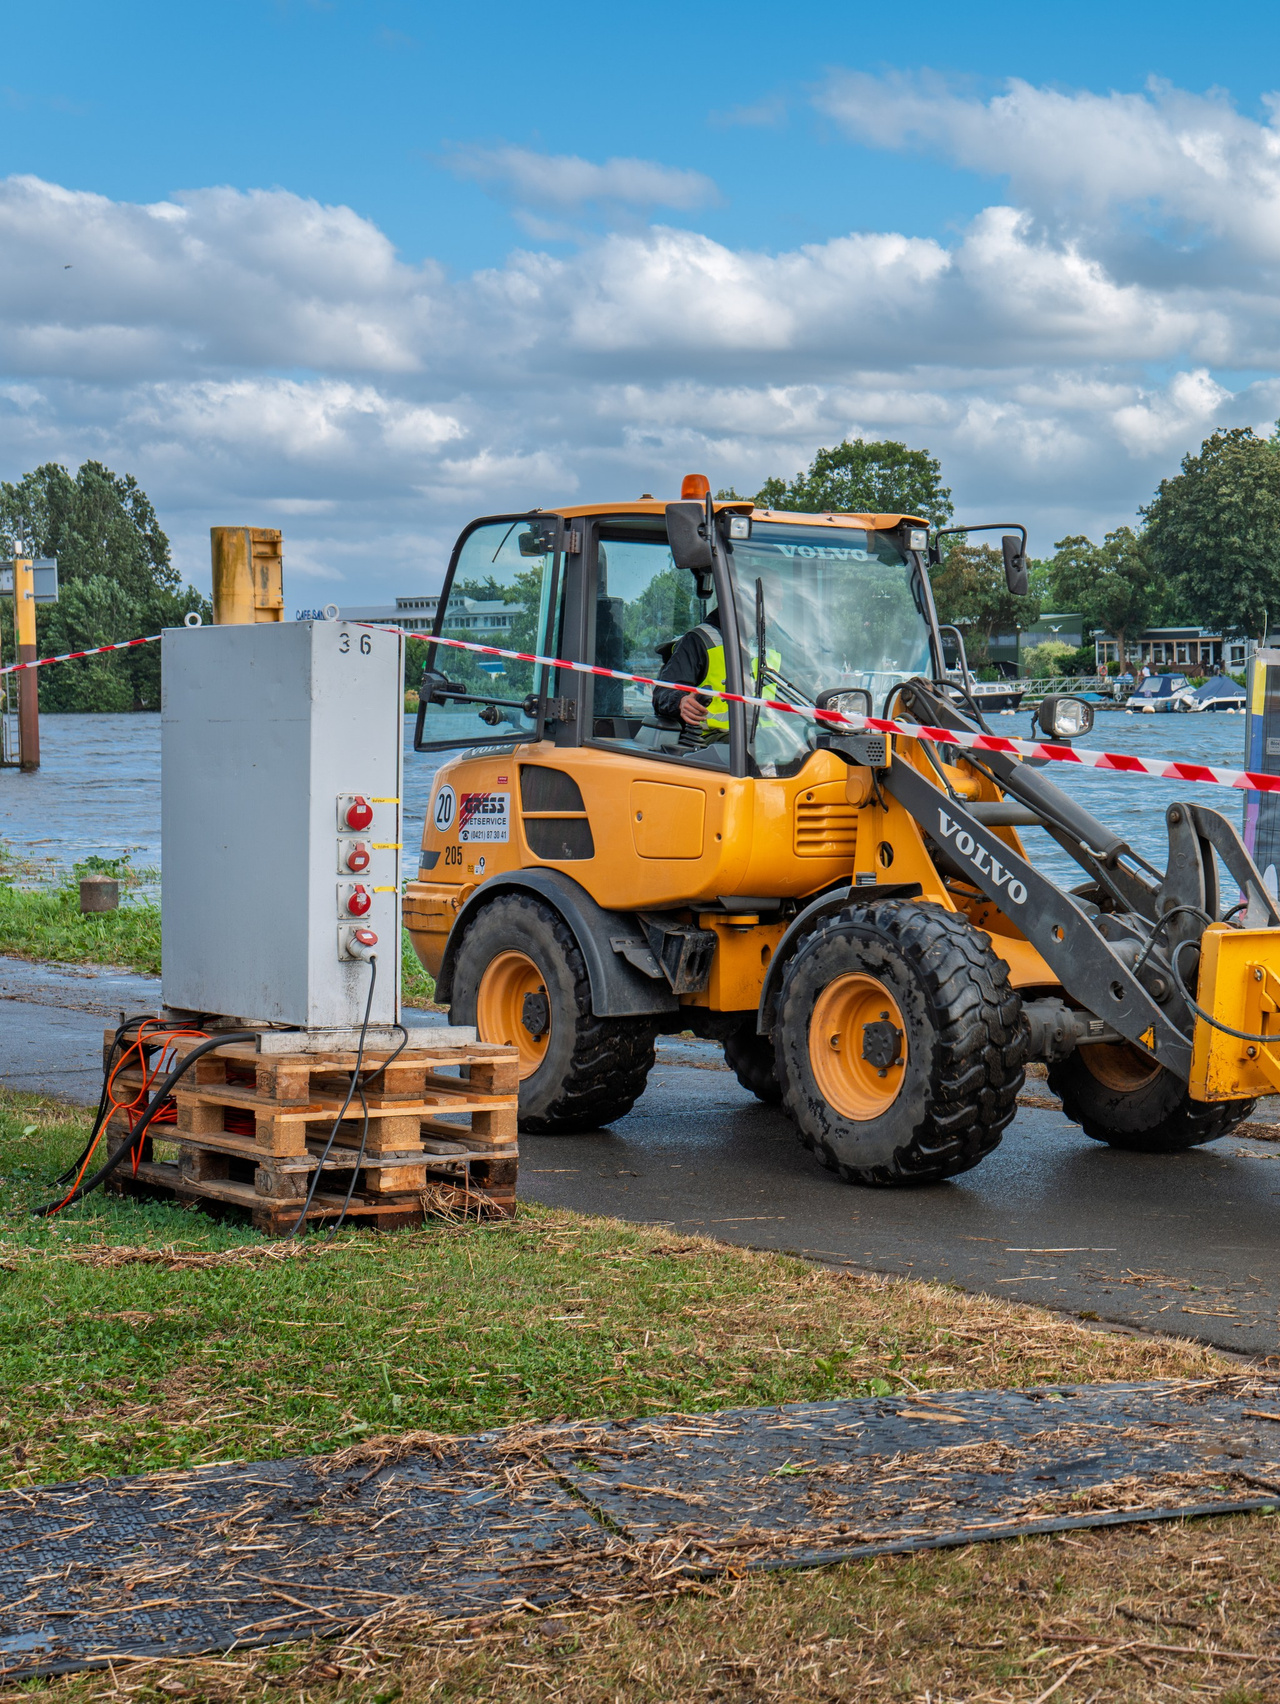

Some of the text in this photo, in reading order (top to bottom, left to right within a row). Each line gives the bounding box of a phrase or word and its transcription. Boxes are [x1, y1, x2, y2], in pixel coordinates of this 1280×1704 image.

[773, 543, 869, 562] VOLVO
[437, 793, 452, 823] 20
[465, 797, 505, 814] GRESS
[471, 830, 507, 841] (0421) 87 30 41
[445, 845, 463, 866] 205
[938, 807, 1028, 905] VOLVO
